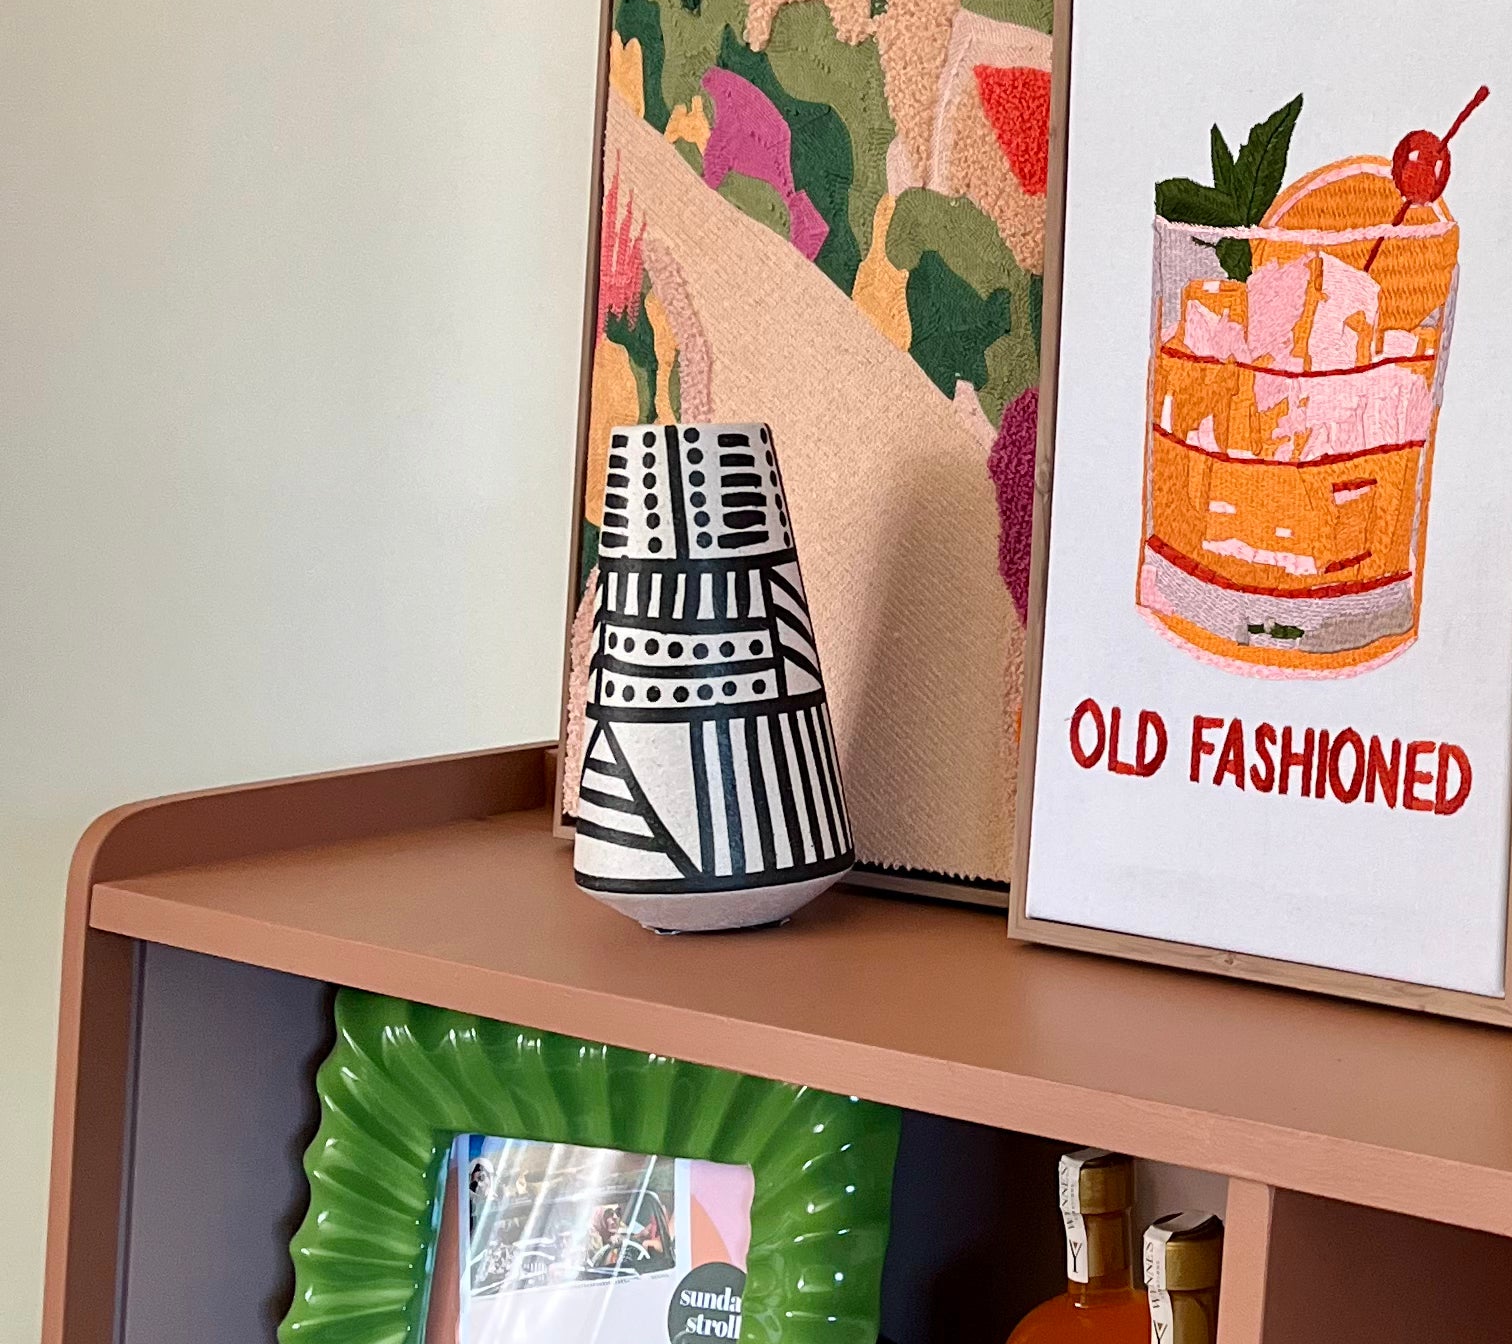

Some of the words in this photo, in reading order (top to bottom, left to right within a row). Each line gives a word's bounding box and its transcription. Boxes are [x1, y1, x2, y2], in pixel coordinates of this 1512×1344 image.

[1069, 698, 1168, 777] OLD
[1189, 715, 1472, 815] FASHIONED
[680, 1287, 742, 1313] sunda
[685, 1314, 742, 1339] stroll
